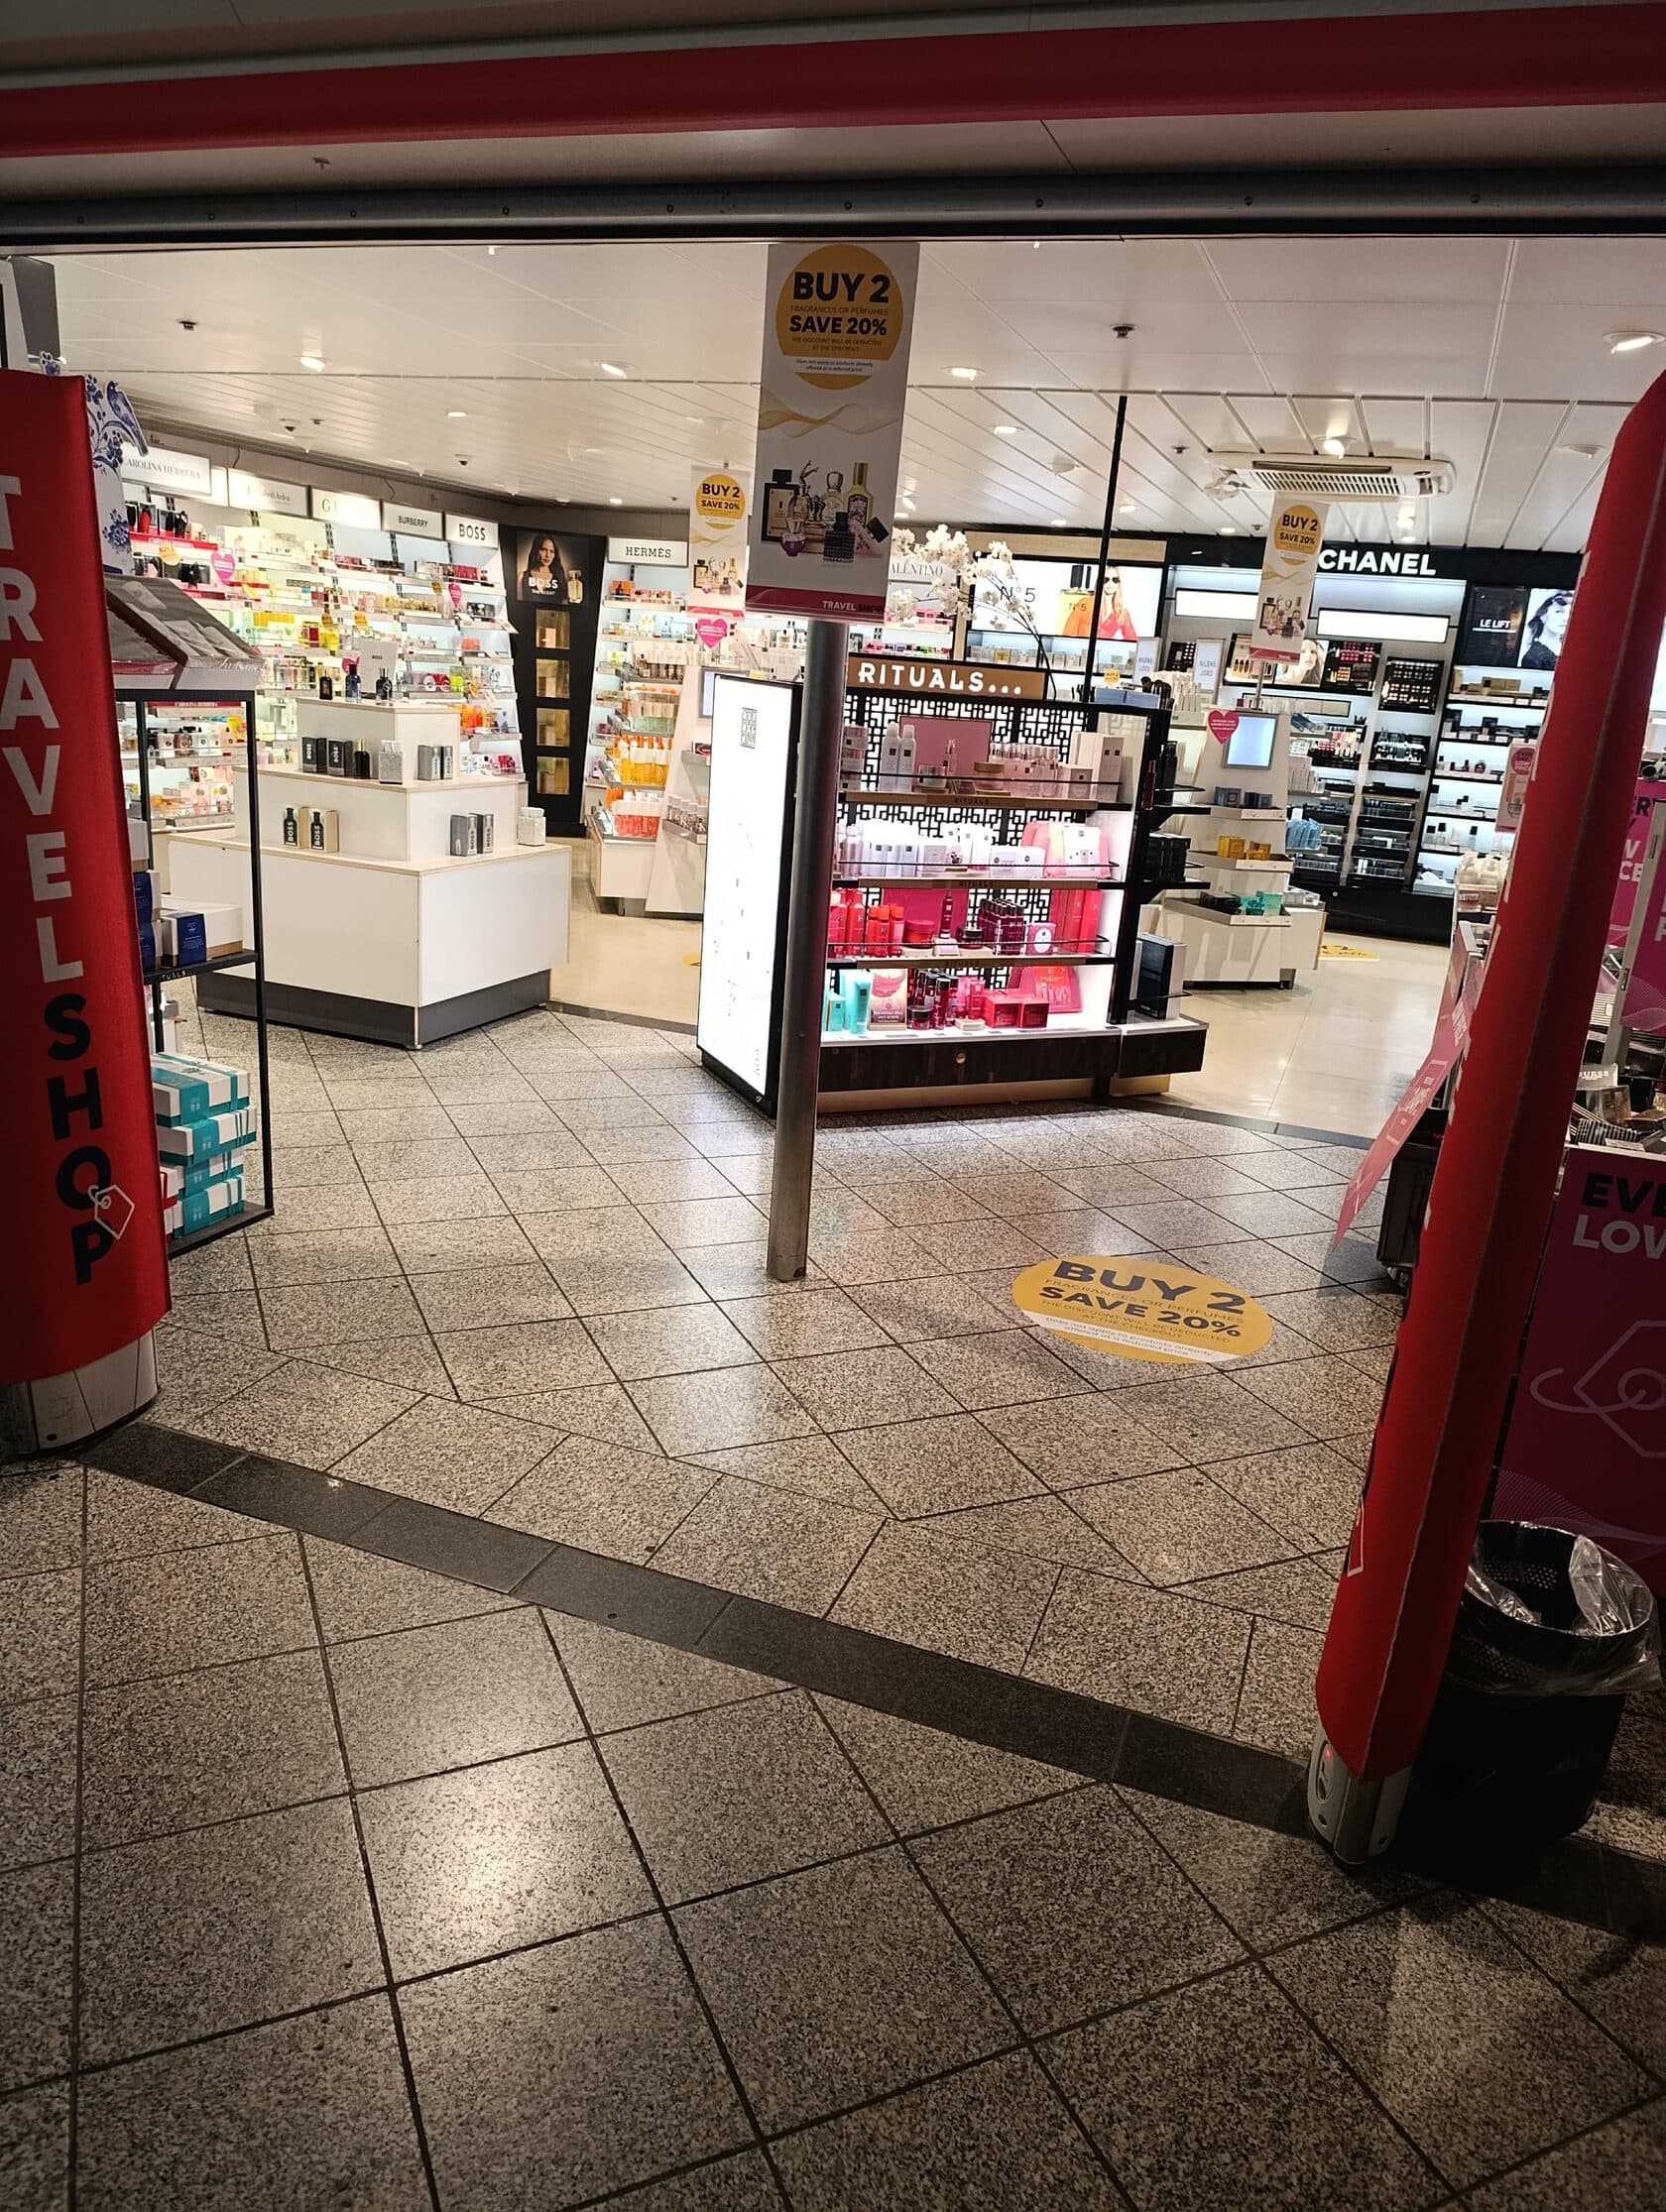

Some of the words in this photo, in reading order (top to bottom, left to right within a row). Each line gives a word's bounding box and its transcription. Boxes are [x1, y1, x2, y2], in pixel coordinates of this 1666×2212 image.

[793, 272, 866, 301] BUY
[869, 274, 891, 303] 2
[790, 304, 837, 313] FRAGRANCES
[789, 314, 843, 334] SAVE
[846, 317, 888, 336] 20%
[126, 458, 163, 473] AROLINA
[701, 483, 731, 496] BUY
[732, 486, 741, 498] 2
[701, 499, 722, 509] SAVE
[724, 502, 740, 511] 20%
[398, 515, 428, 528] BURBERRY
[1281, 514, 1309, 529] BUY
[1310, 519, 1318, 531] 2
[458, 523, 486, 541] BOSS
[1279, 532, 1299, 543] SAVE
[1299, 533, 1316, 544] 20%
[890, 561, 944, 576] ALENTINO
[1318, 548, 1437, 576] CHANEL
[528, 576, 558, 589] BOSS
[822, 600, 857, 612] TRAVEL
[1480, 619, 1492, 629] LE
[1493, 620, 1512, 630] LIFT
[1053, 1260, 1197, 1301] BUY
[1206, 1292, 1247, 1315] 2
[1044, 1279, 1137, 1302] FRAGRANCES
[1141, 1299, 1163, 1308] OR
[1167, 1304, 1244, 1325] PERFUMES
[1038, 1286, 1148, 1318] SAVE
[1157, 1310, 1242, 1338] 20%
[1063, 1304, 1120, 1320] DISCOUNT
[1122, 1317, 1148, 1326] WILL
[1169, 1327, 1232, 1343] DEDUCTED
[1122, 1322, 1184, 1339] CHECKOUT
